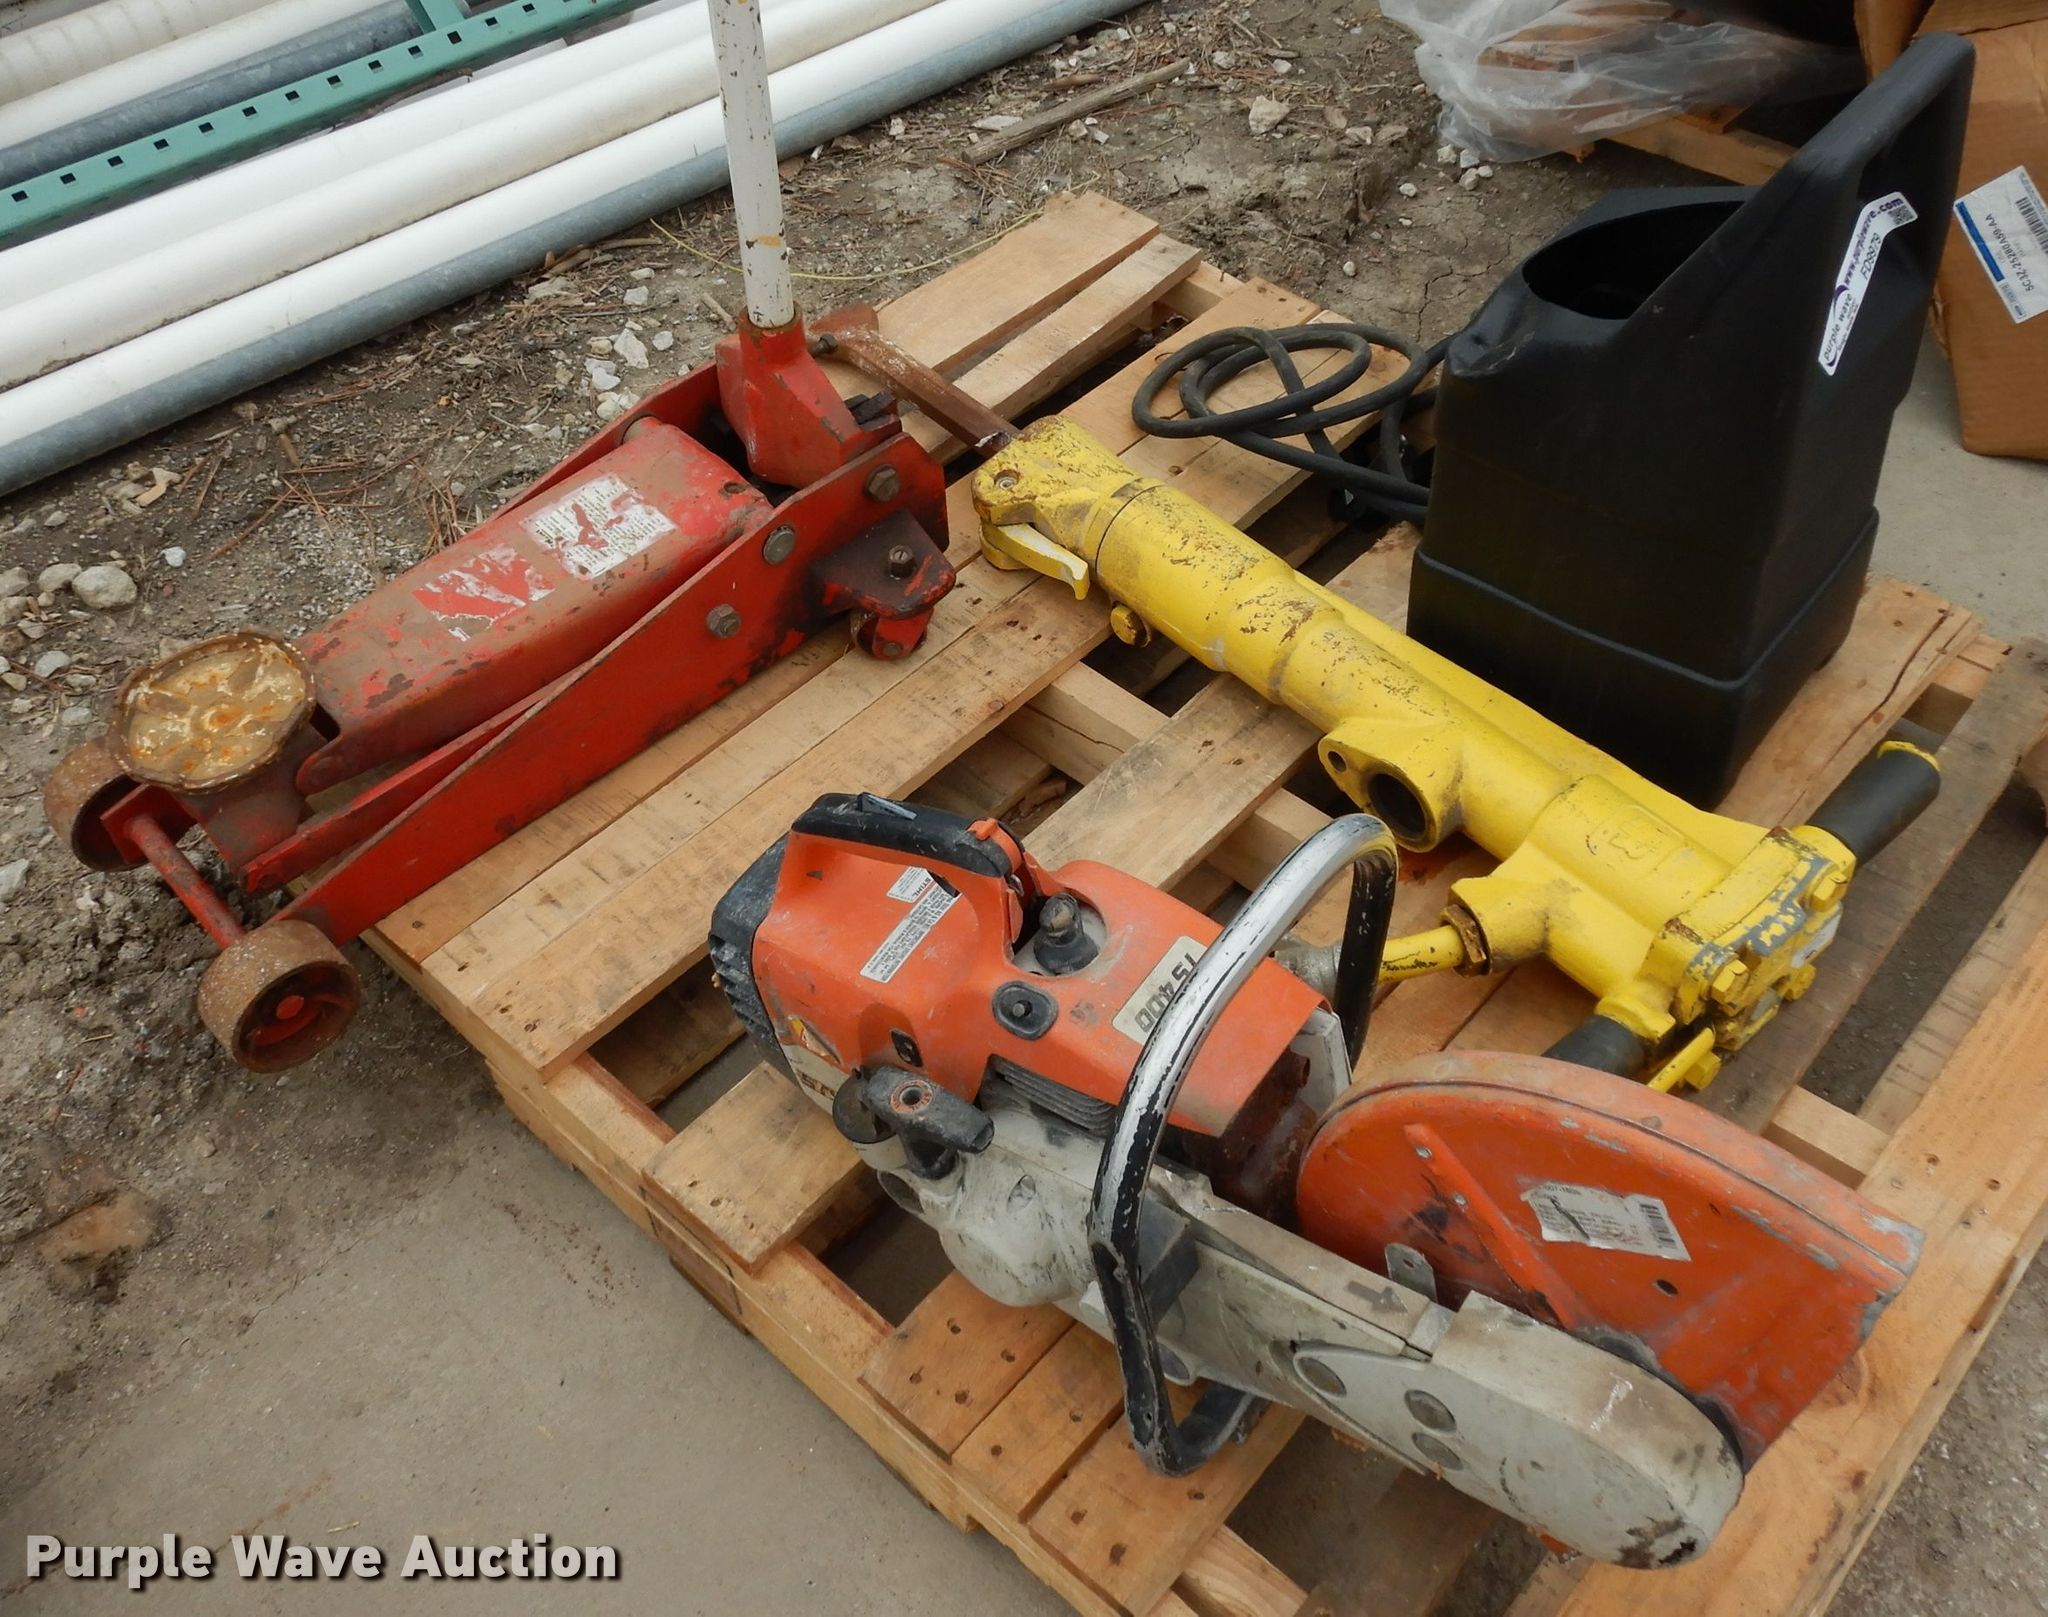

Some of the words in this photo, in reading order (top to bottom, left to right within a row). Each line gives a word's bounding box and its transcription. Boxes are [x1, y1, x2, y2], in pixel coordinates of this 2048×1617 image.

[1843, 198, 1904, 286] www.purplewave.com
[1860, 232, 1881, 280] FD9979
[1823, 323, 1841, 361] purple
[1838, 293, 1853, 322] wave
[912, 877, 931, 897] STIHL
[1134, 981, 1175, 1033] 400
